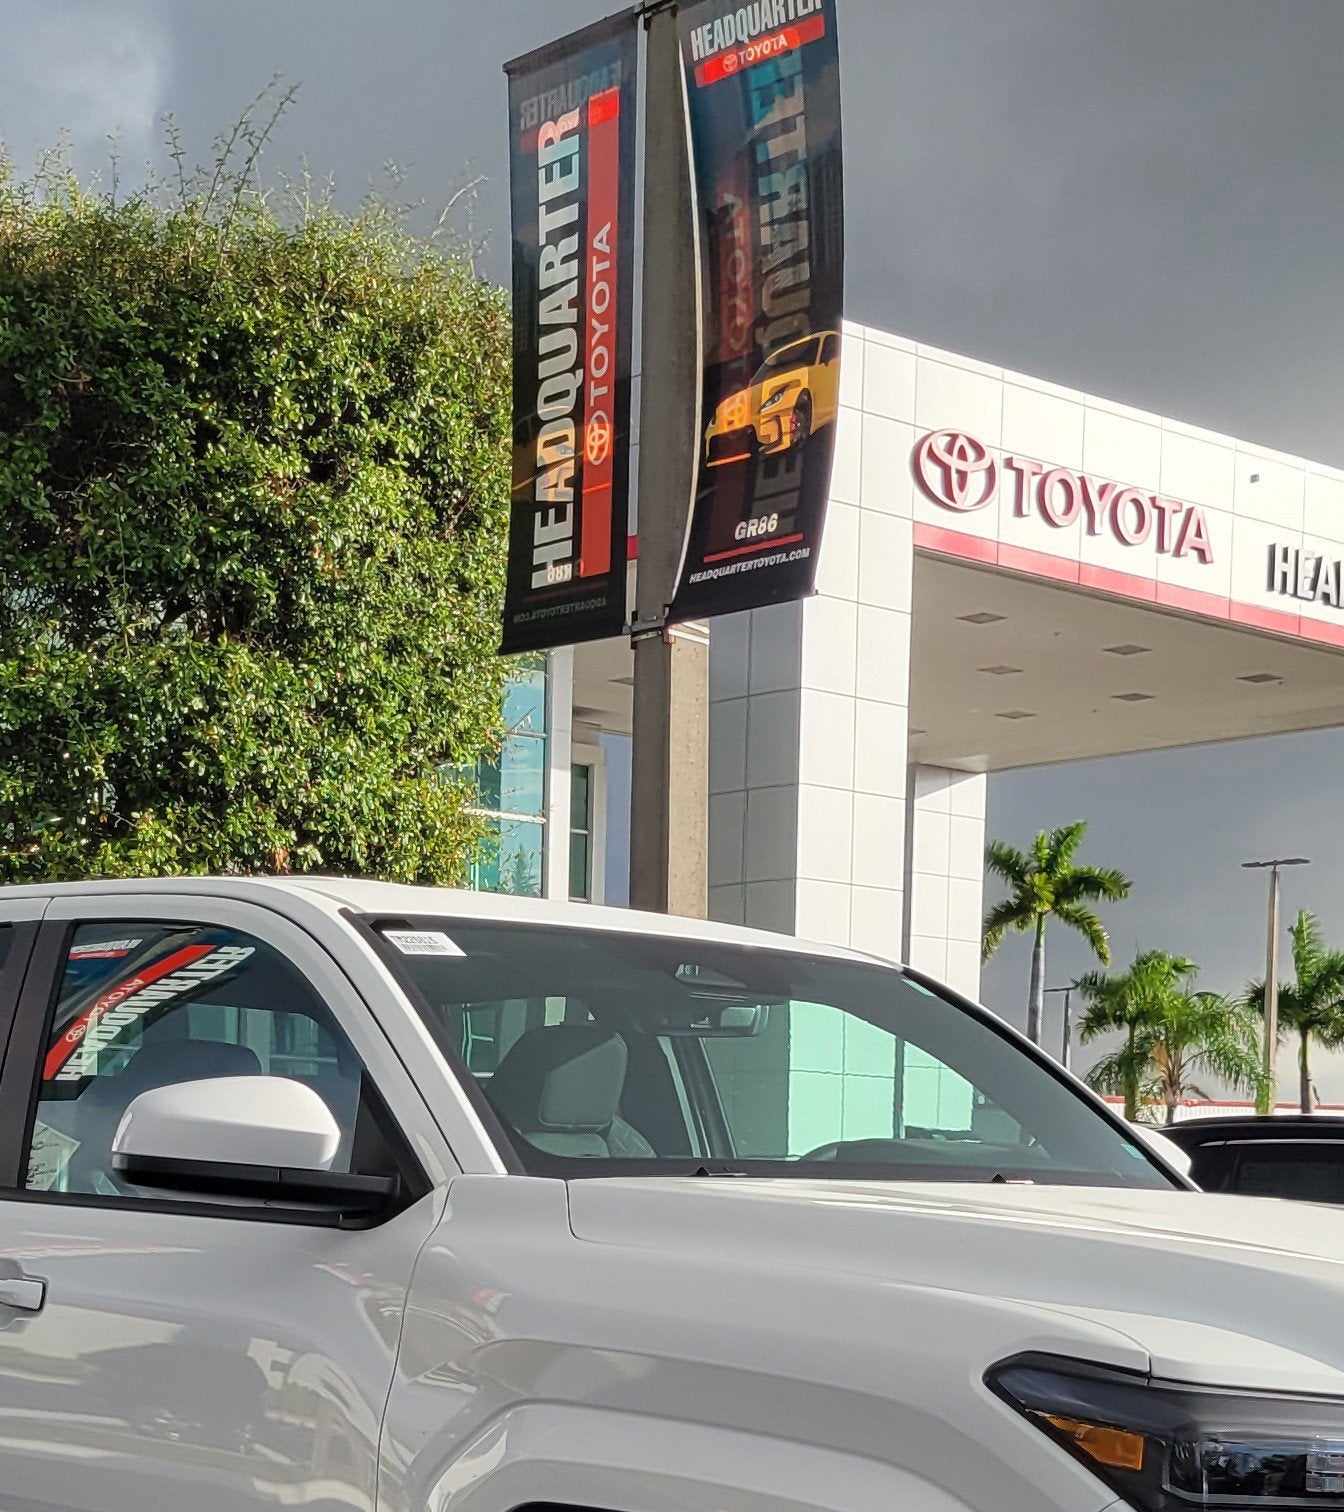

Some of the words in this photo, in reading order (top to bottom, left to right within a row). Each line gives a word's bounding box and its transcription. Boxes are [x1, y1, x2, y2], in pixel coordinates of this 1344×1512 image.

[738, 34, 788, 65] TOYOTA
[531, 106, 580, 590] HEADQUARTER
[586, 221, 612, 408] TOYOTA
[734, 512, 779, 541] GR86
[1003, 456, 1214, 565] TOYOTA
[688, 547, 811, 584] HEADQUARTERTOYOTA.COM
